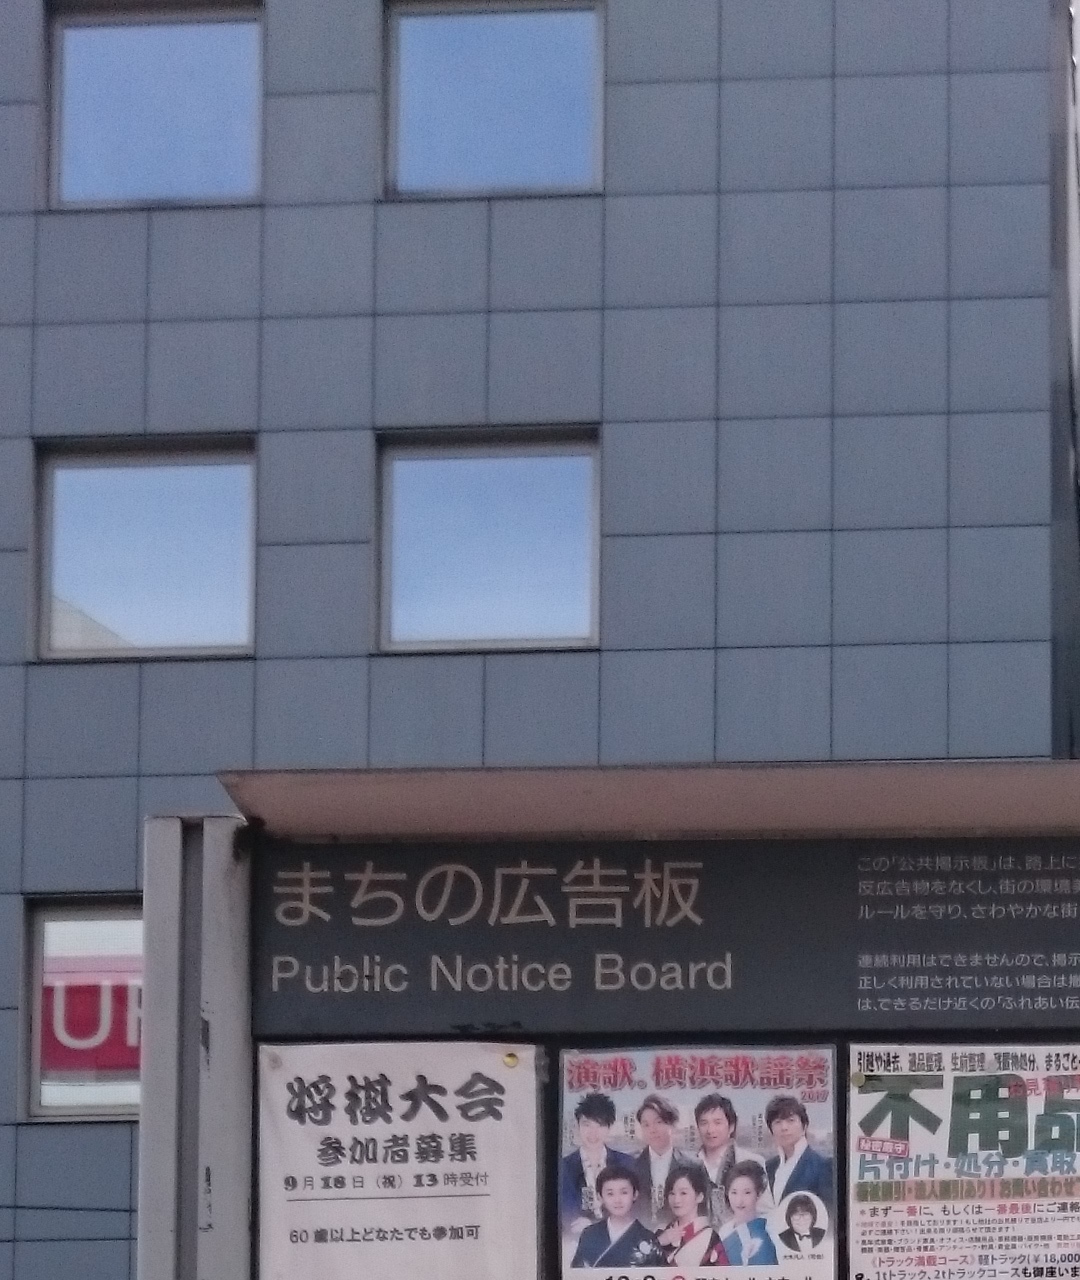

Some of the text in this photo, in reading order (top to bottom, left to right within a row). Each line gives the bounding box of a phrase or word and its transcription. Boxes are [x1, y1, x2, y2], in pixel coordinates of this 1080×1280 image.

[272, 858, 704, 929] まちの広告板
[271, 953, 733, 993] Public Notice Board
[566, 1054, 829, 1091] 演歌。横浜歌謡祭
[286, 1072, 506, 1127] 将棋大会
[317, 1133, 478, 1166] 参加者募集
